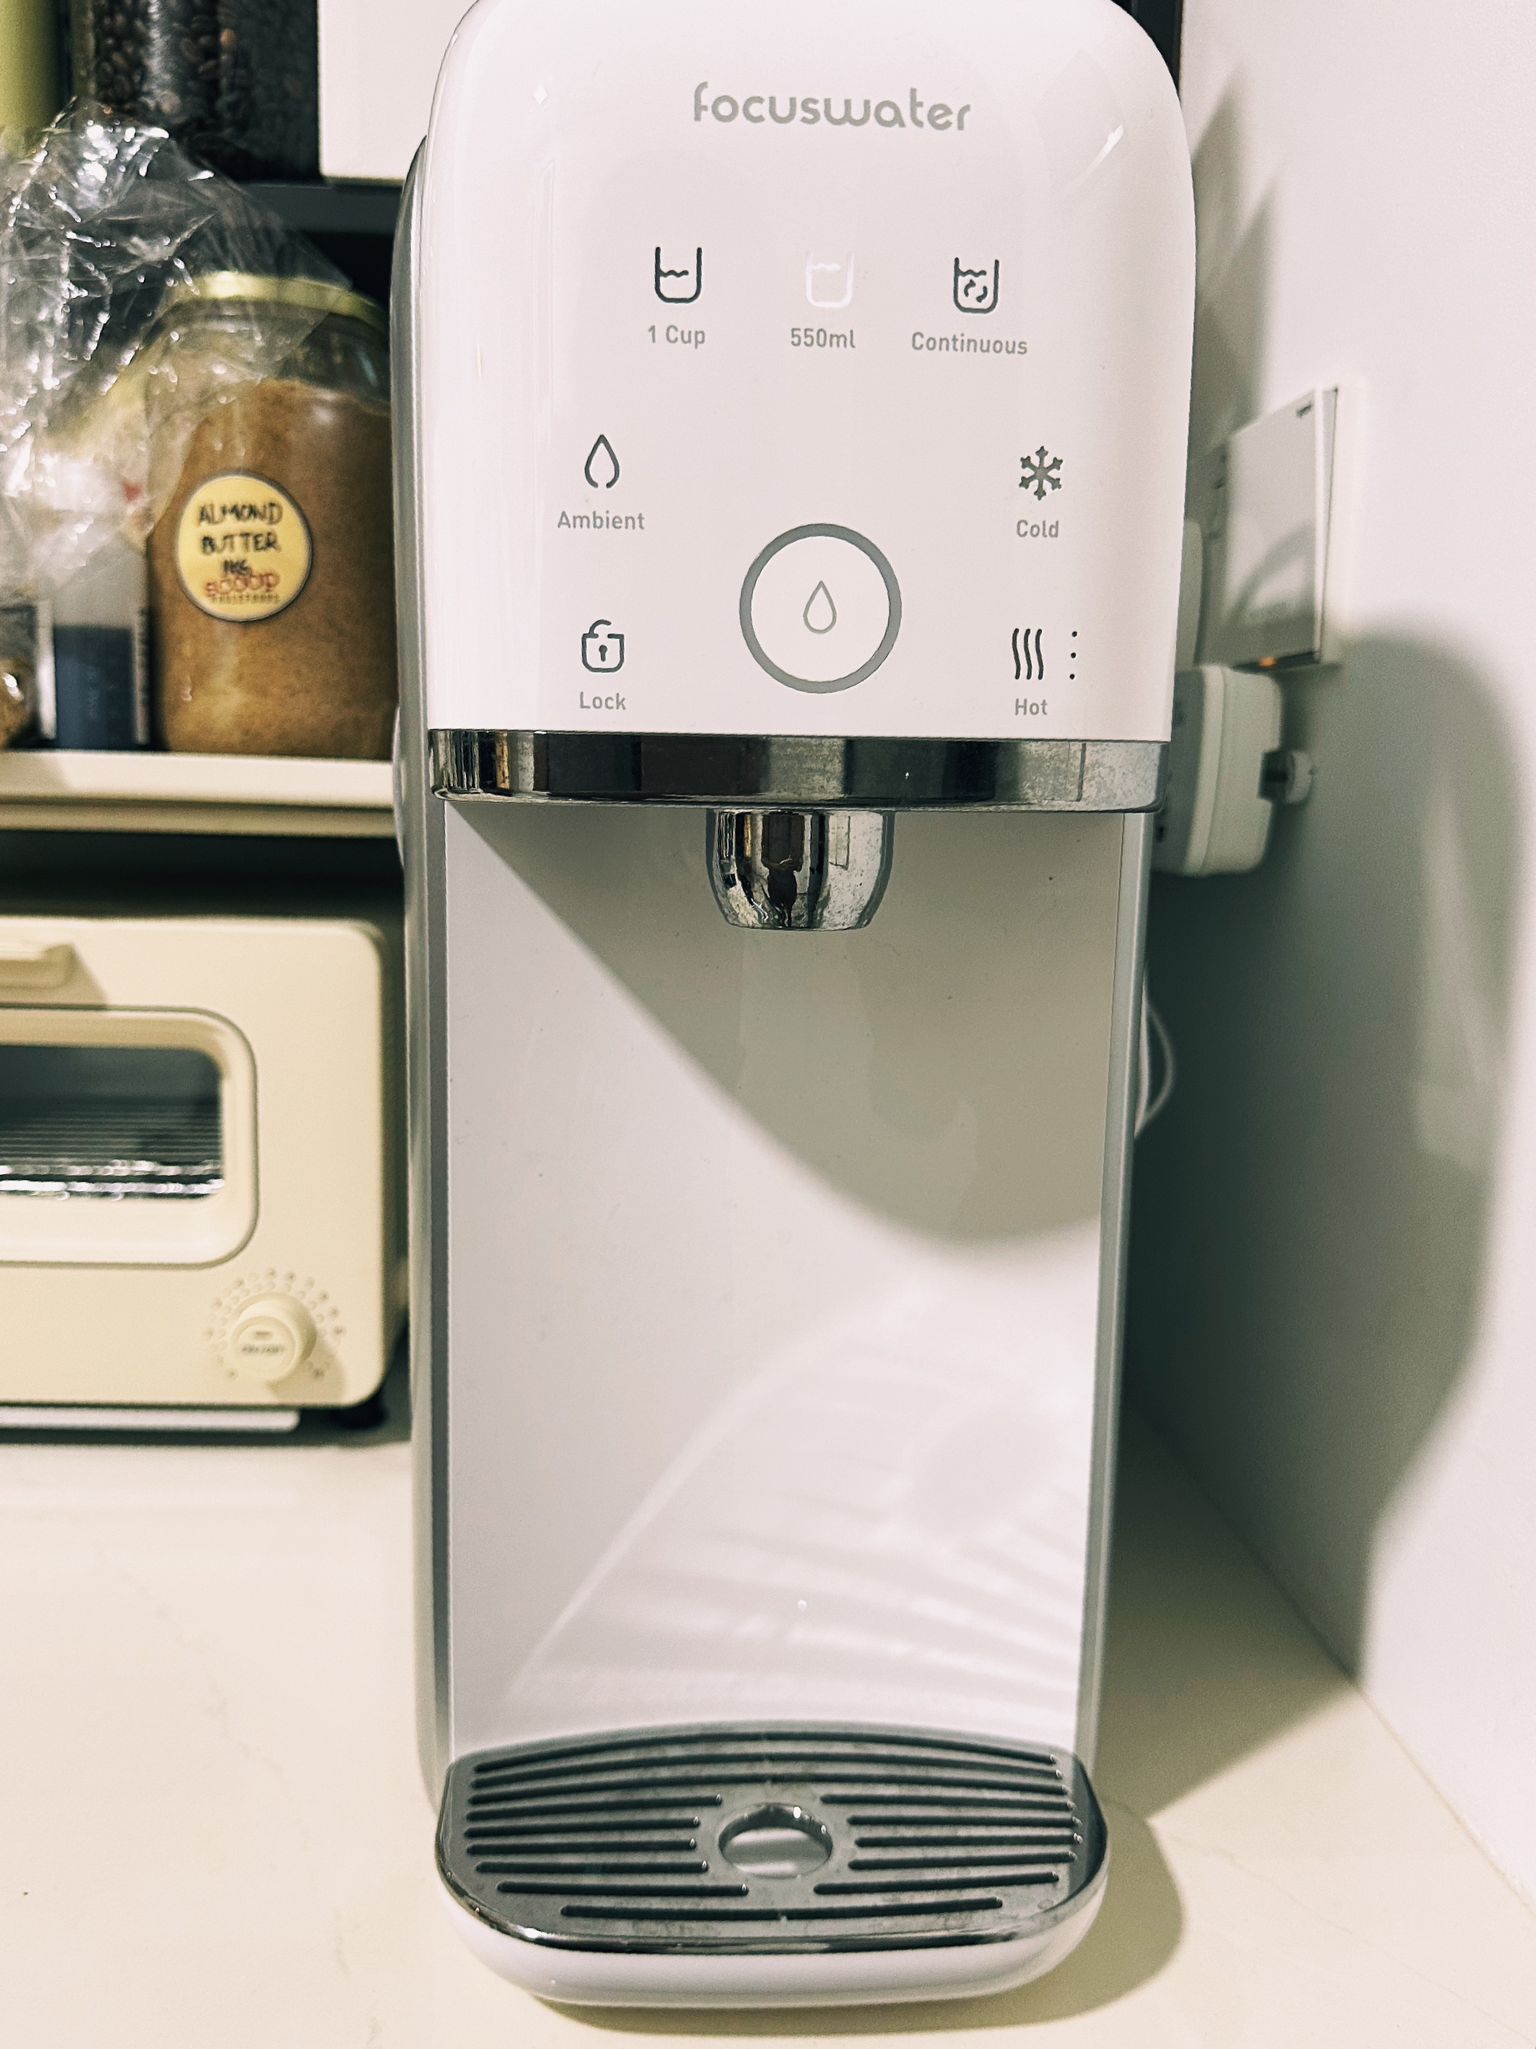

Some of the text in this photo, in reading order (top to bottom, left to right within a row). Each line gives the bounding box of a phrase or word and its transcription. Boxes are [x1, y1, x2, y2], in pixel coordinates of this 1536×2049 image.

[693, 80, 971, 131] focuswater
[647, 325, 706, 350] 1 Cup
[790, 327, 856, 349] 550ml
[911, 331, 1028, 356] Continuous
[198, 501, 282, 525] ALMOND
[557, 509, 645, 531] Ambient
[1016, 519, 1060, 539] Cold
[201, 531, 279, 555] BUTTER
[579, 691, 627, 711] Lock
[1014, 697, 1048, 716] Hot
